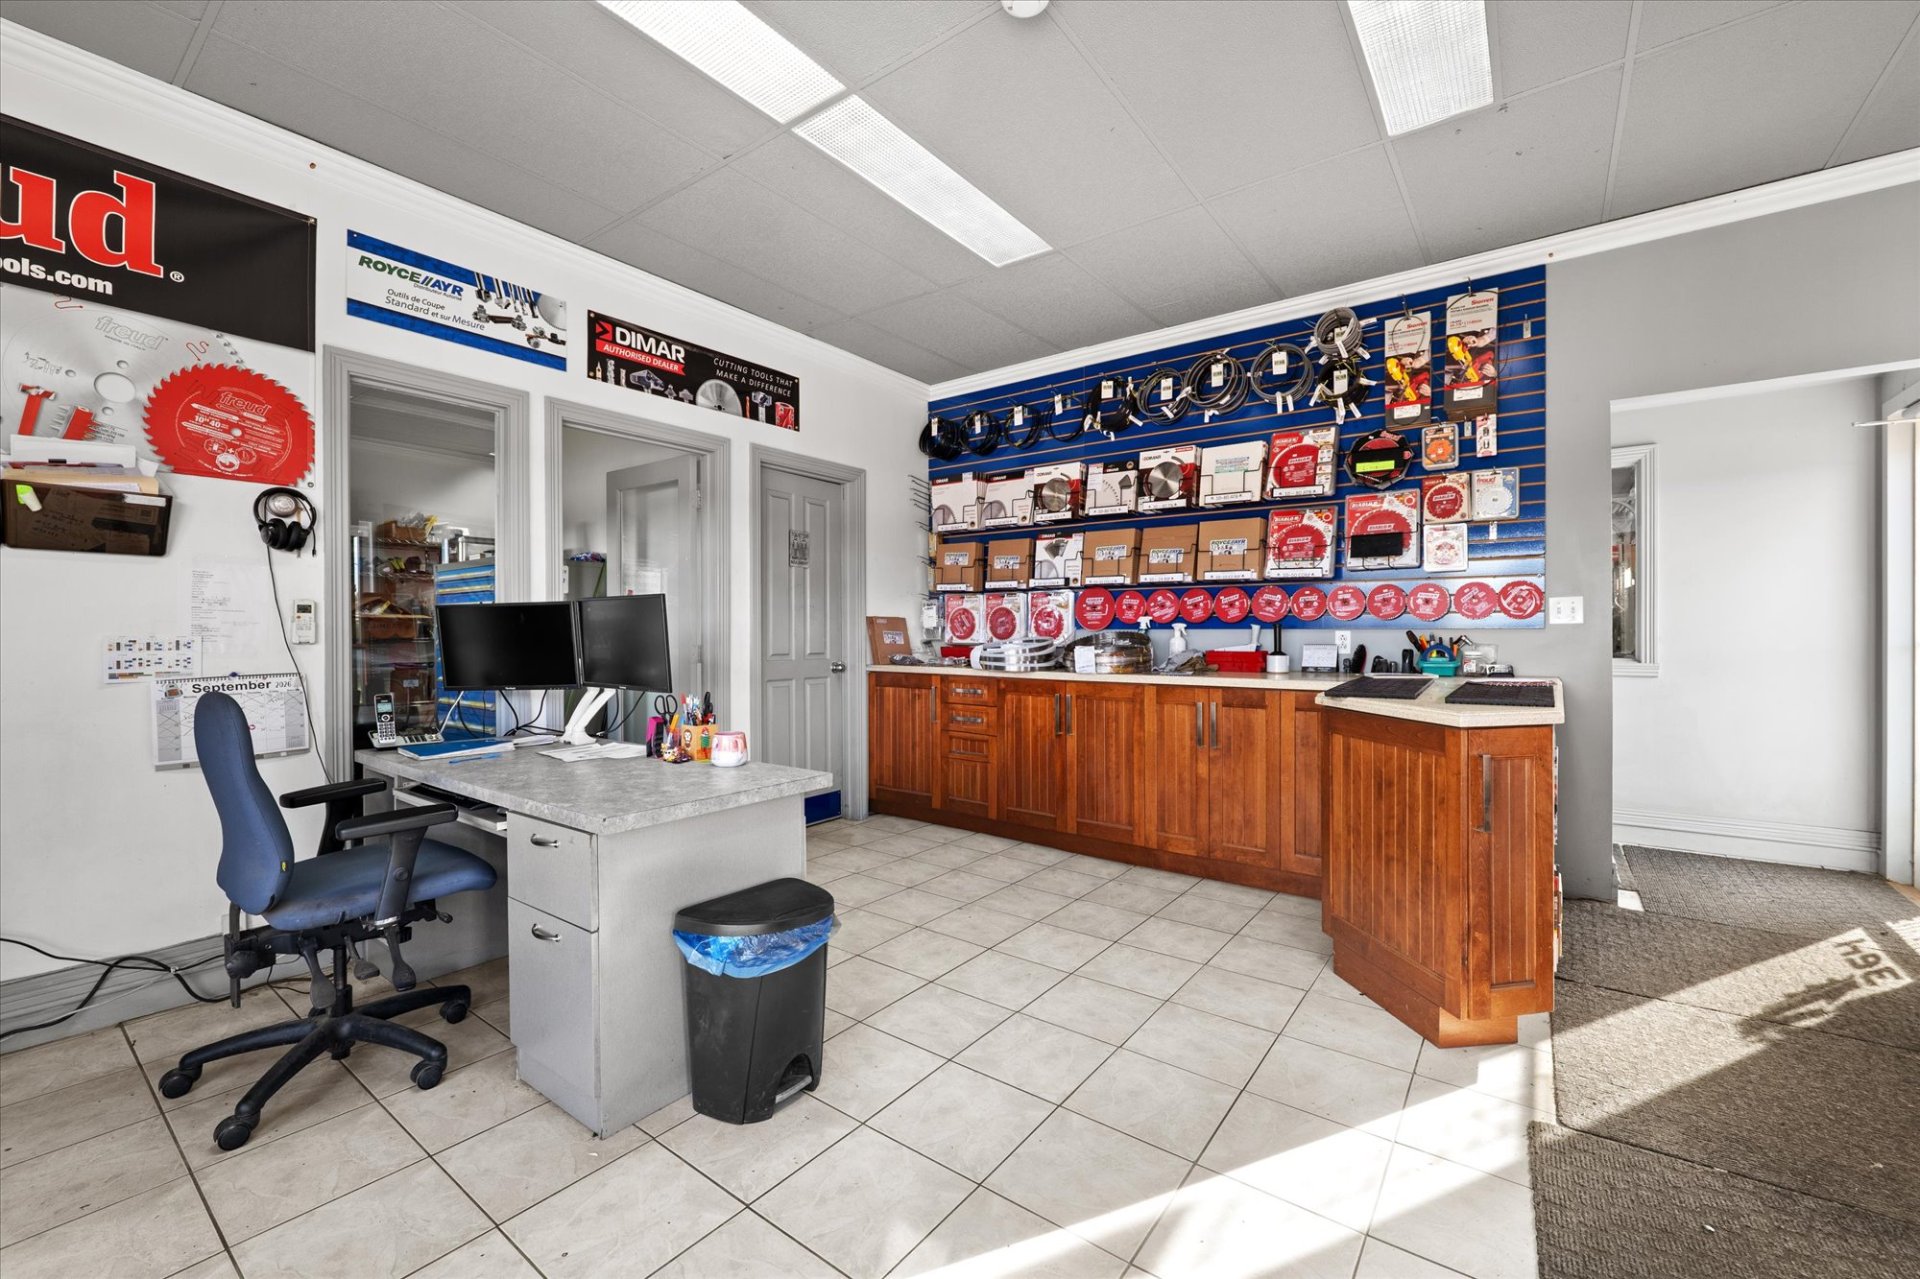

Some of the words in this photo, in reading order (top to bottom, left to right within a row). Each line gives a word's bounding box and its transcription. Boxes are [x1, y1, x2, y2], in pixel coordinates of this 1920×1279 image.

[0, 257, 113, 295] ols.com
[385, 295, 430, 316] Standard
[439, 313, 451, 321] sur
[452, 314, 486, 331] Mesure
[387, 288, 409, 301] Outils
[410, 295, 421, 303] de
[421, 297, 446, 311] Coupe
[603, 344, 652, 364] AUTHORISED
[652, 358, 679, 372] DEALER
[615, 326, 685, 363] DIMAR
[713, 357, 748, 374] CUTTING
[750, 368, 774, 382] TOOLS
[775, 376, 794, 387] THAT
[716, 369, 738, 382] MAKE
[740, 376, 746, 384] A
[749, 379, 792, 397] DIFFERENCE
[219, 391, 272, 417] freud
[192, 681, 271, 694] September
